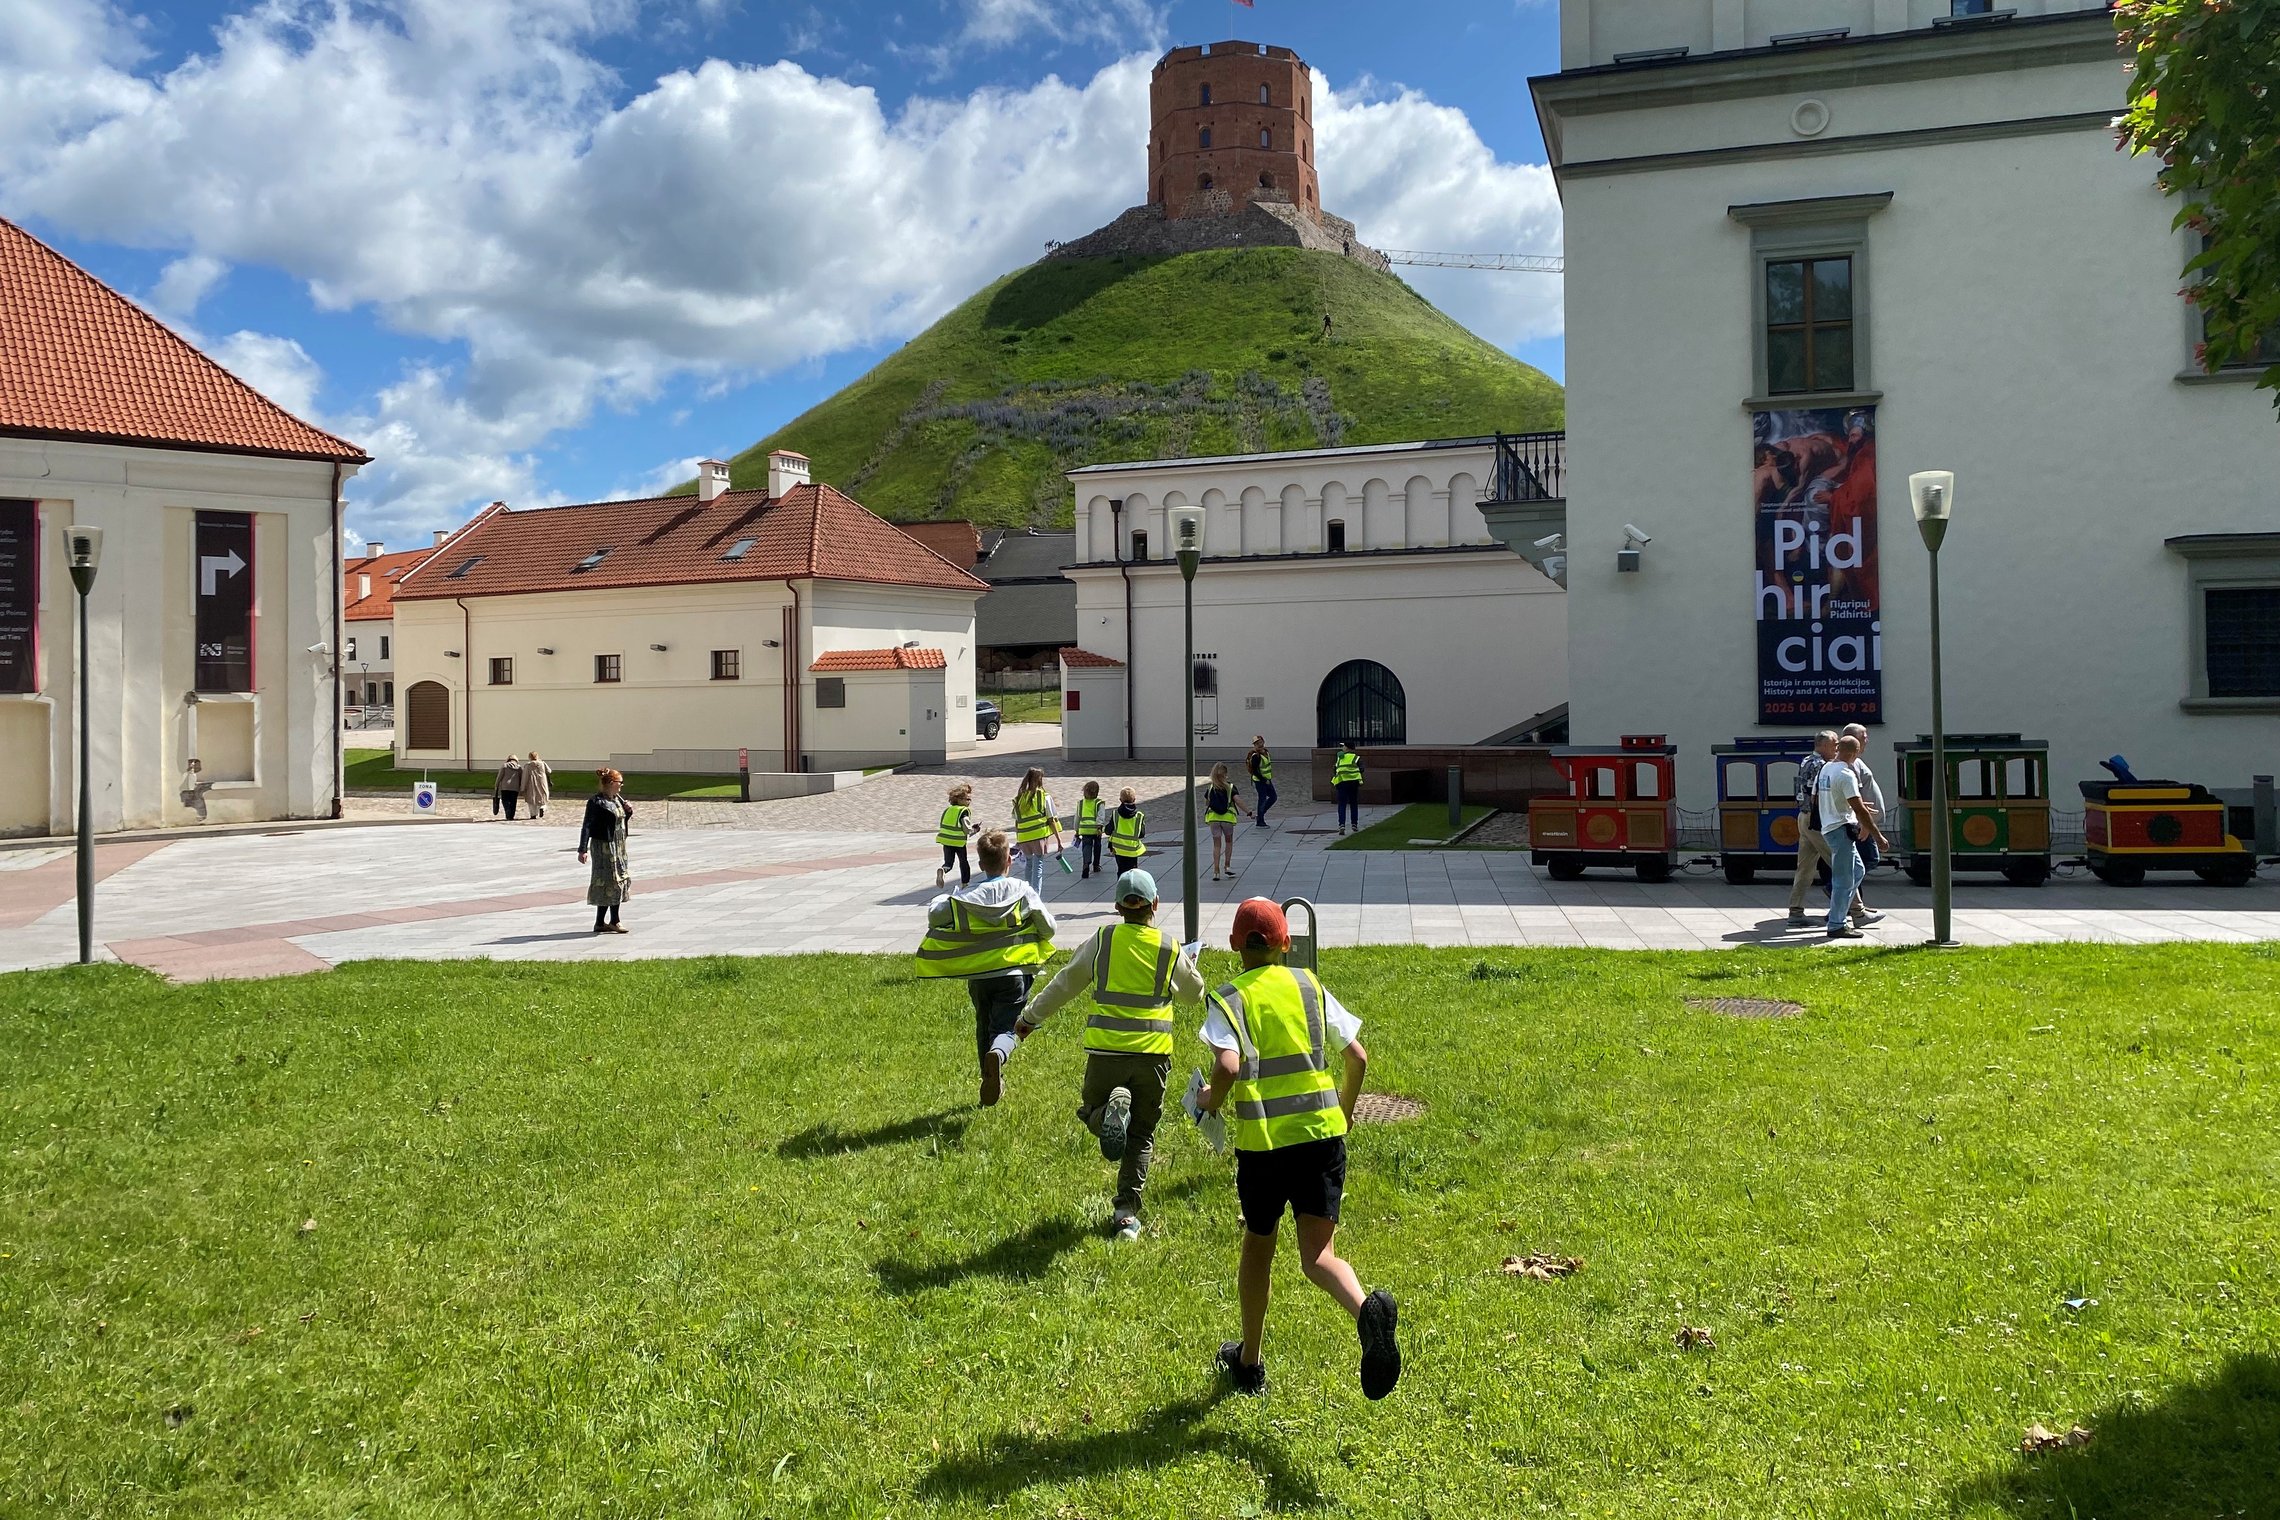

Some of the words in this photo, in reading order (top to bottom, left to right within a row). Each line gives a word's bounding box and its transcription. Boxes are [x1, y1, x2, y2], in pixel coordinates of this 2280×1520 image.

[1774, 516, 1863, 570] Pid
[1755, 570, 1831, 620] hir
[1830, 610, 1872, 619] Pidhirtsi
[1776, 620, 1882, 672] ciai
[1763, 679, 1793, 688] Istorija
[1828, 678, 1870, 687] kolekcijos
[1764, 688, 1794, 697] History
[1795, 687, 1812, 695] and
[1814, 687, 1827, 695] Art
[1829, 687, 1876, 695] Collections
[1765, 703, 1795, 713] 2025
[1799, 703, 1814, 713] 04
[1861, 702, 1876, 713] 28
